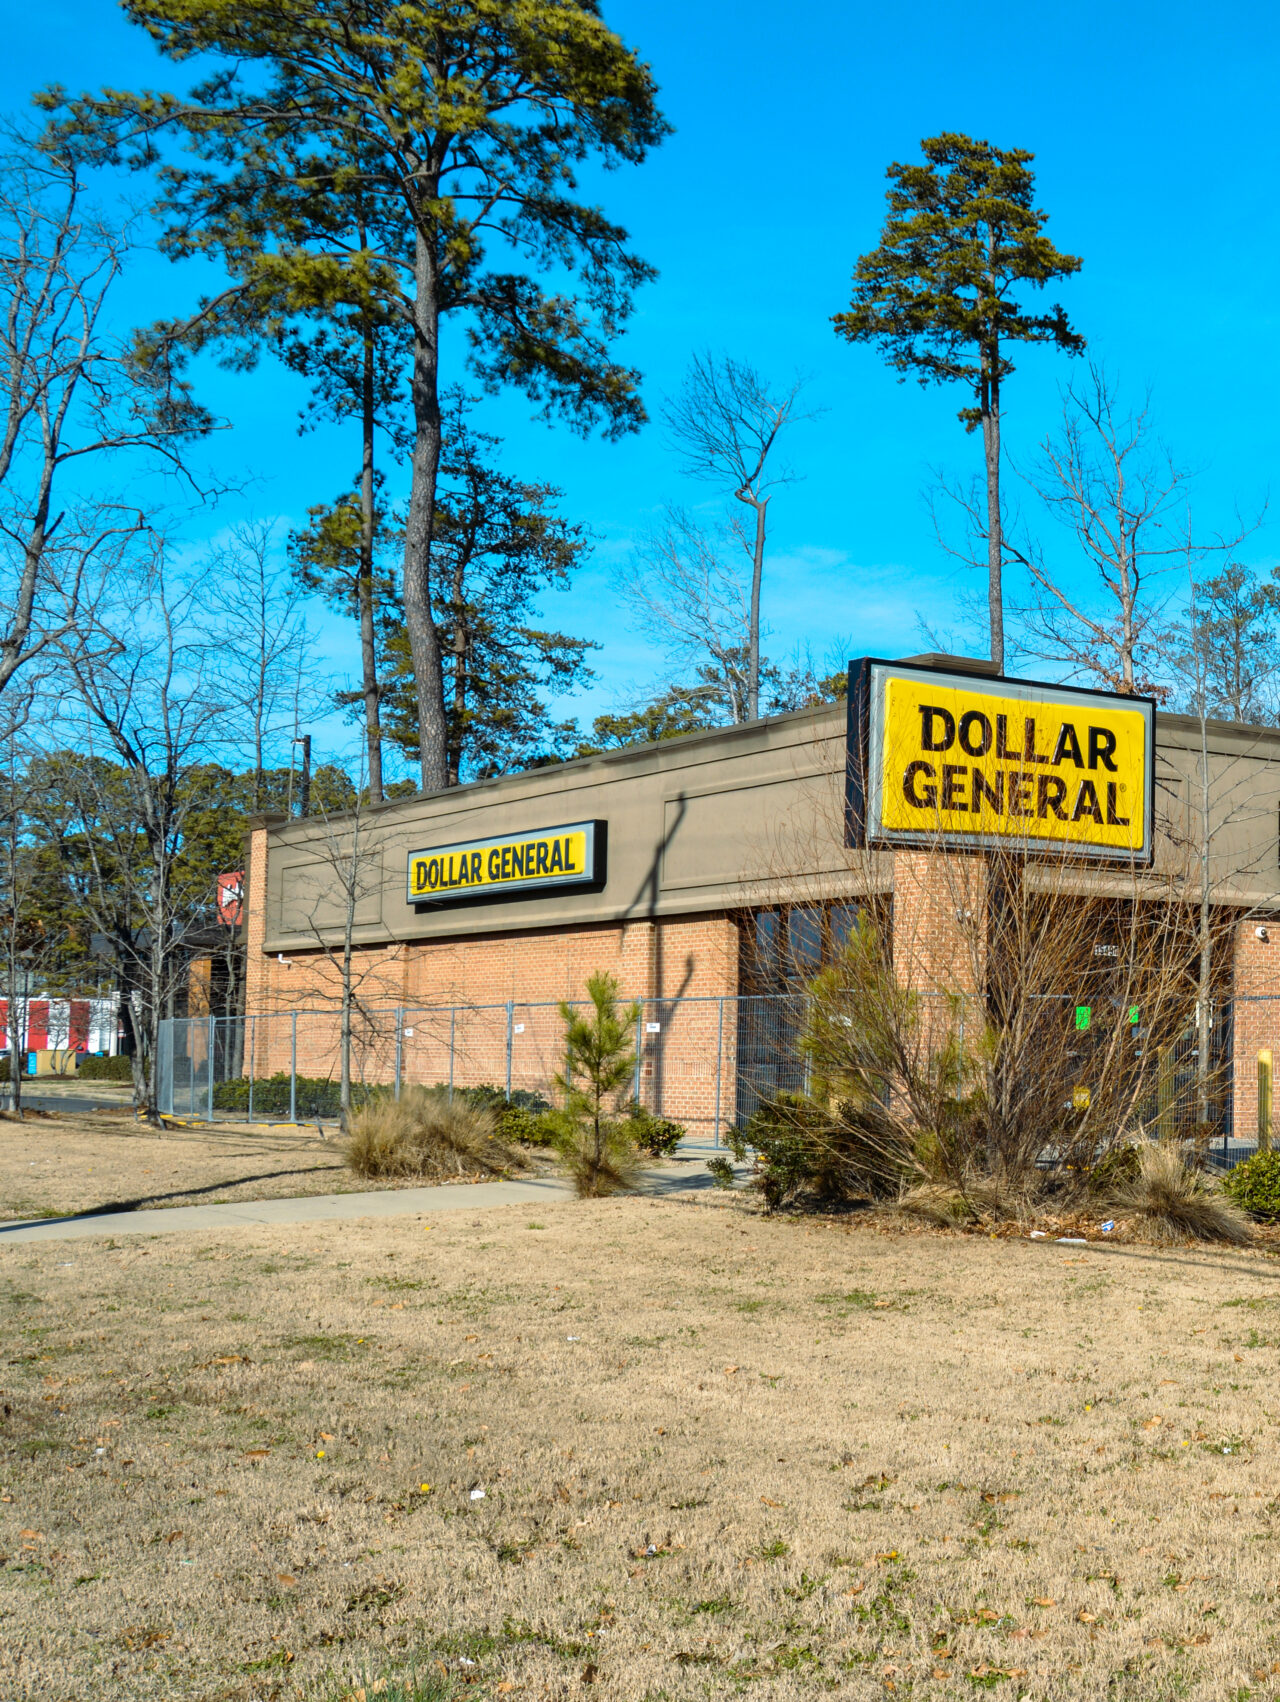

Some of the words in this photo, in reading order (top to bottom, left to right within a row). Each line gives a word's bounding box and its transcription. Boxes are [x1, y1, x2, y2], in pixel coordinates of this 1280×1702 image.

[918, 704, 1118, 772] DOLLAR
[903, 760, 1130, 827] GENERAL
[416, 852, 482, 891] DOLLAR
[488, 837, 575, 881] GENERAL
